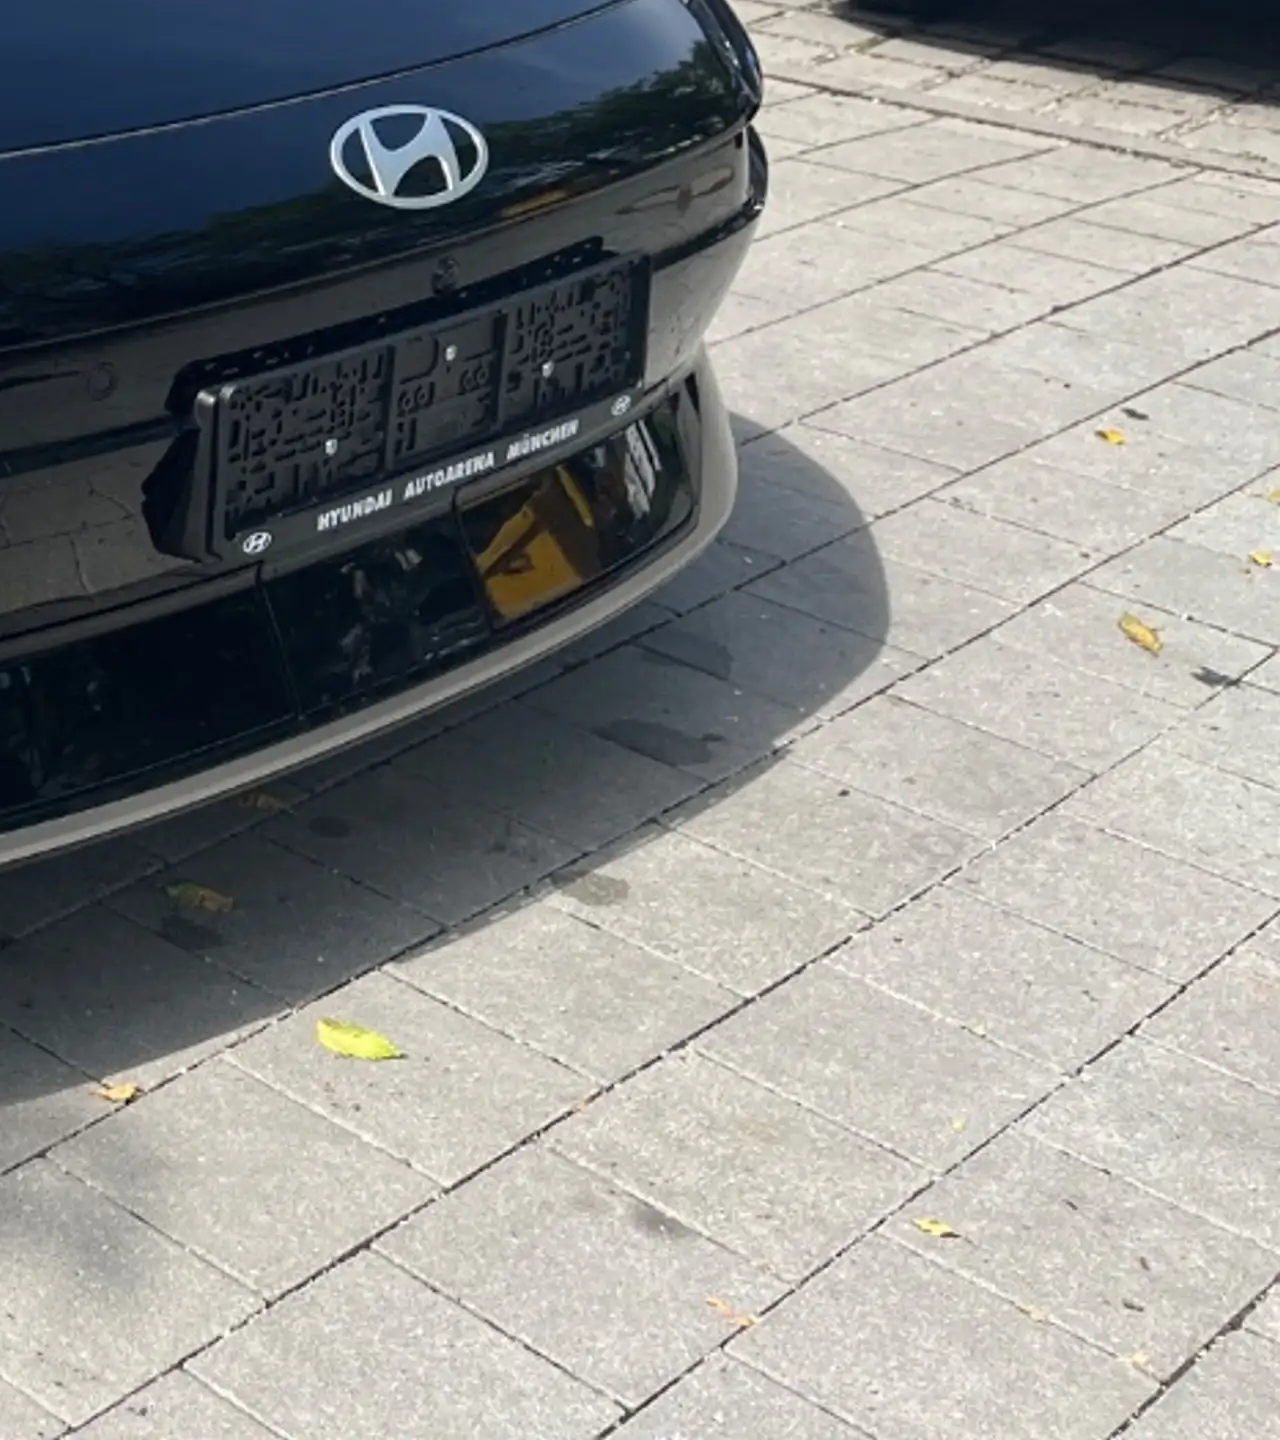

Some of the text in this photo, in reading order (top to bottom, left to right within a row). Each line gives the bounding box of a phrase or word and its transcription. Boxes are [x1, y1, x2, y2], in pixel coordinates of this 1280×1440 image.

[316, 418, 580, 532] HYUNDAI AUTOARENA MÜNCHEN
